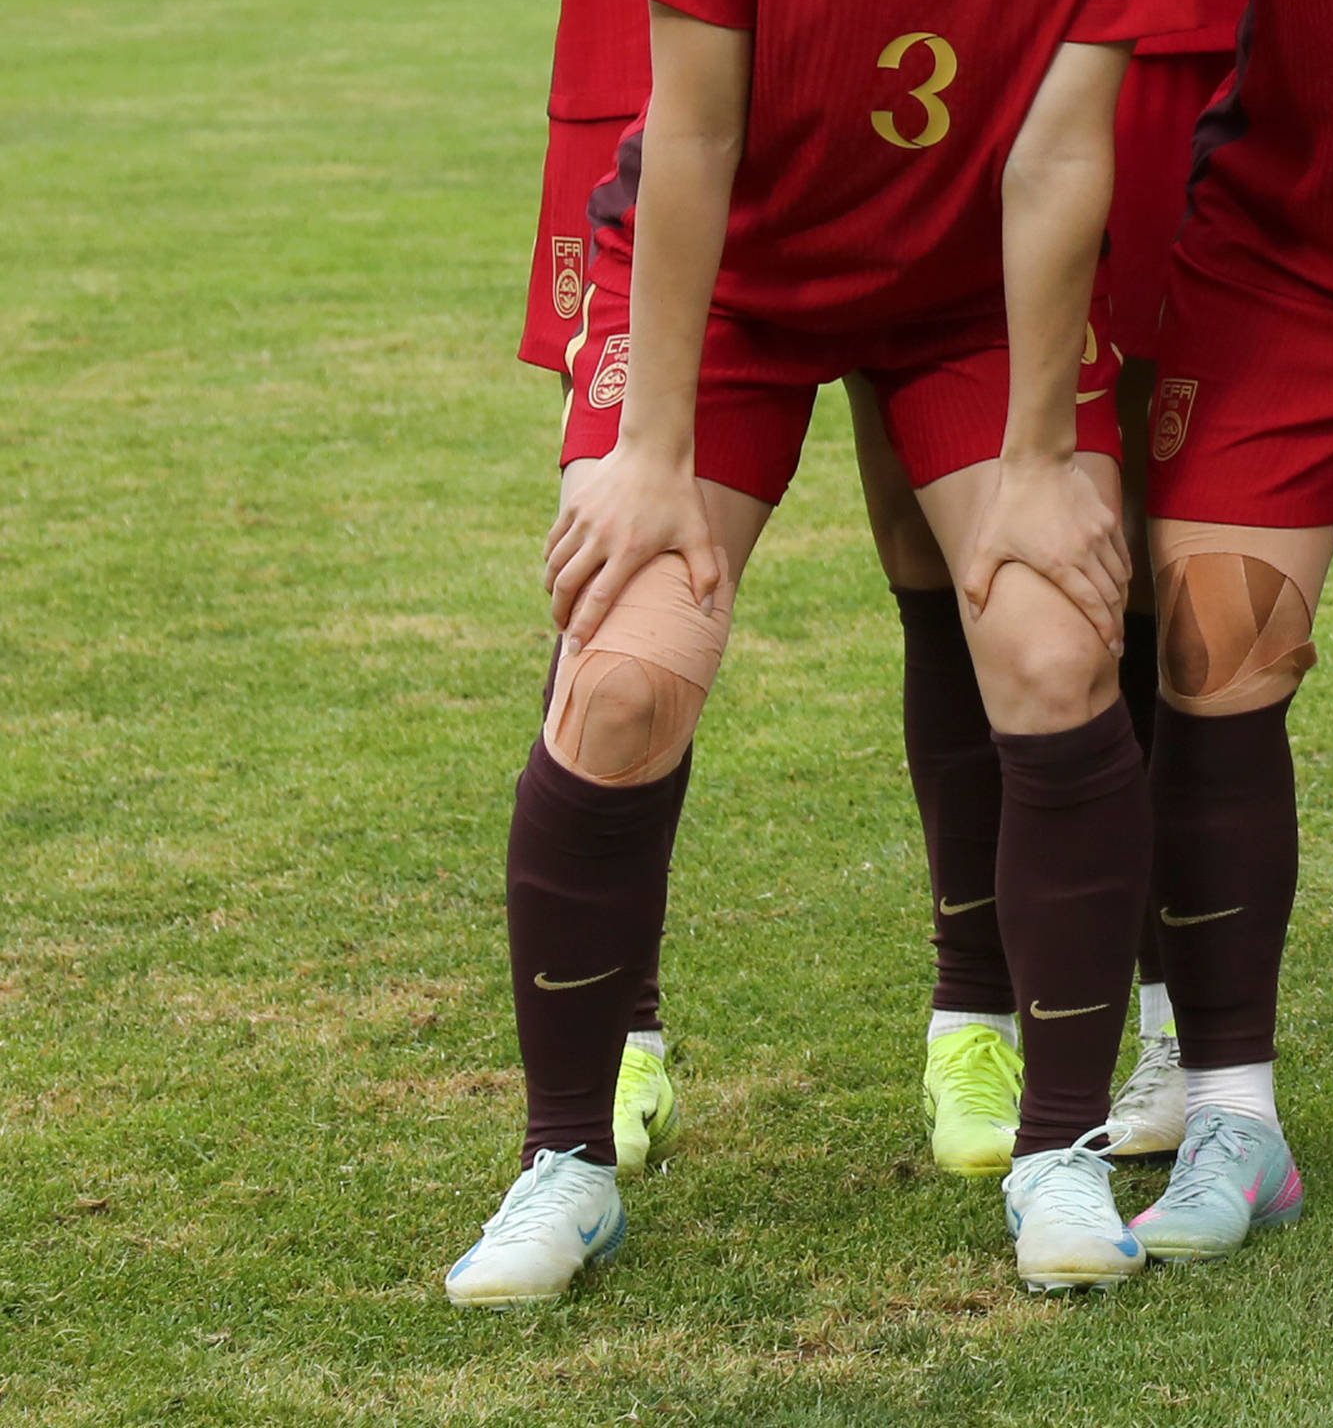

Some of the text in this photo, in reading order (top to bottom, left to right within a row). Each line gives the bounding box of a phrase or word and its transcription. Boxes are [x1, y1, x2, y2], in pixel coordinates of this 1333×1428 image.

[871, 32, 957, 149] 3
[555, 242, 581, 258] CFA
[607, 339, 630, 354] CF
[1162, 384, 1192, 400] CFA
